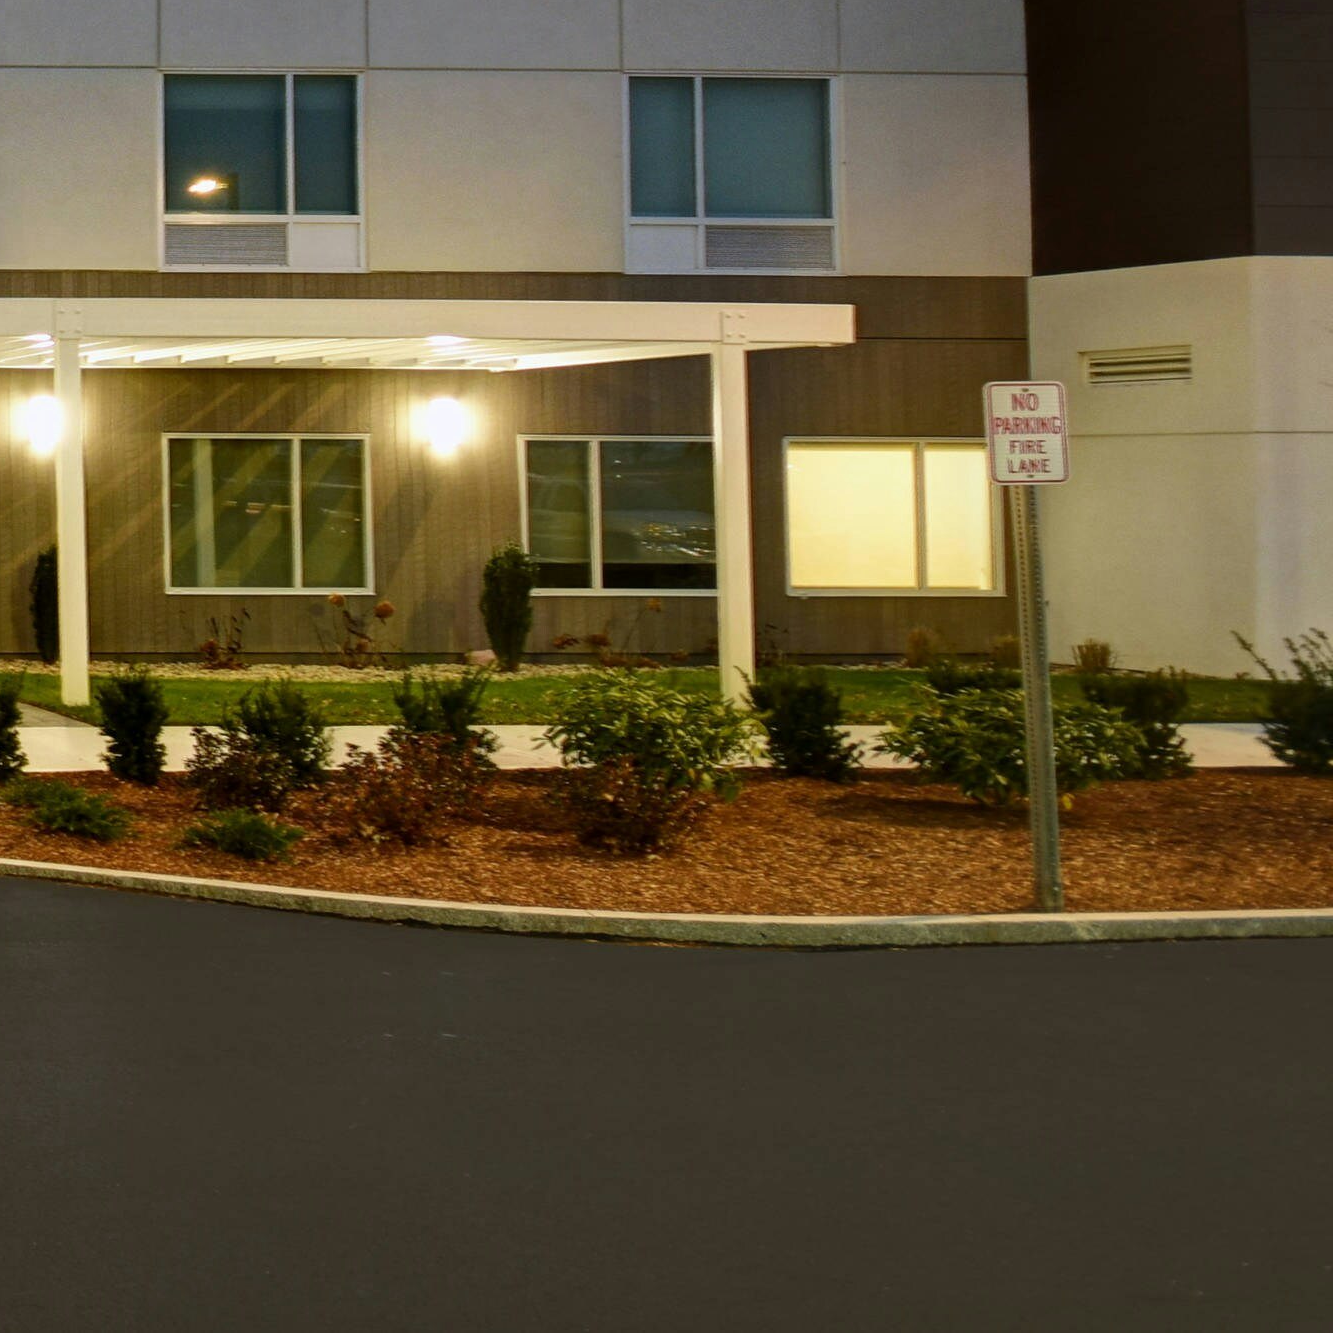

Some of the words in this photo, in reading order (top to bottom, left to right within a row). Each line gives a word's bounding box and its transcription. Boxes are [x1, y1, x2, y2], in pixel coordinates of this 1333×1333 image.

[1011, 393, 1039, 411] NO
[992, 417, 1062, 434] PARKING
[1009, 440, 1047, 454] FIRE
[1007, 458, 1051, 473] LANE
